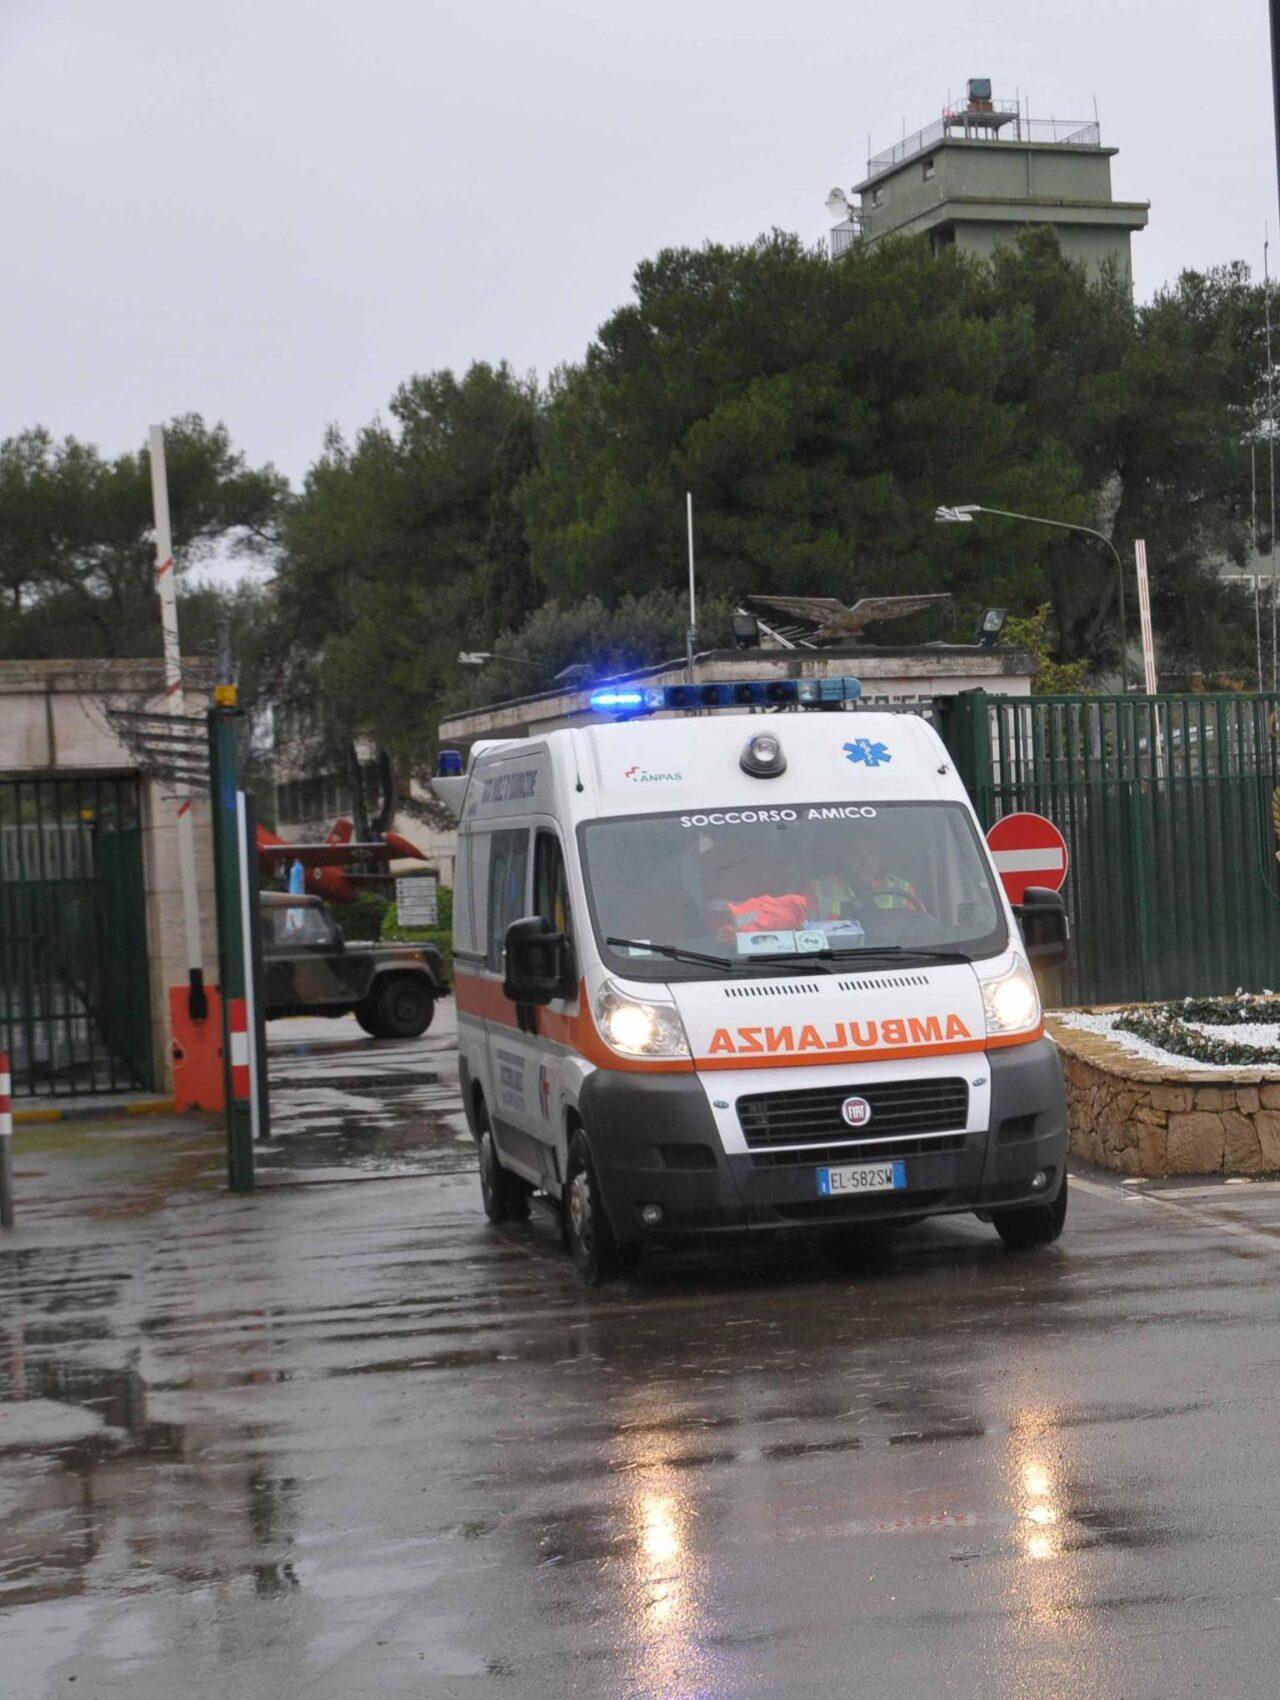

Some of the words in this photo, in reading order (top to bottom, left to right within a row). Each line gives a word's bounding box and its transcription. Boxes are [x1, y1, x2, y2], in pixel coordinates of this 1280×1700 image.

[640, 773, 683, 783] ANPAS
[679, 809, 797, 828] SOCCORSO
[807, 806, 877, 821] AMICO
[847, 1105, 865, 1119] FIAT
